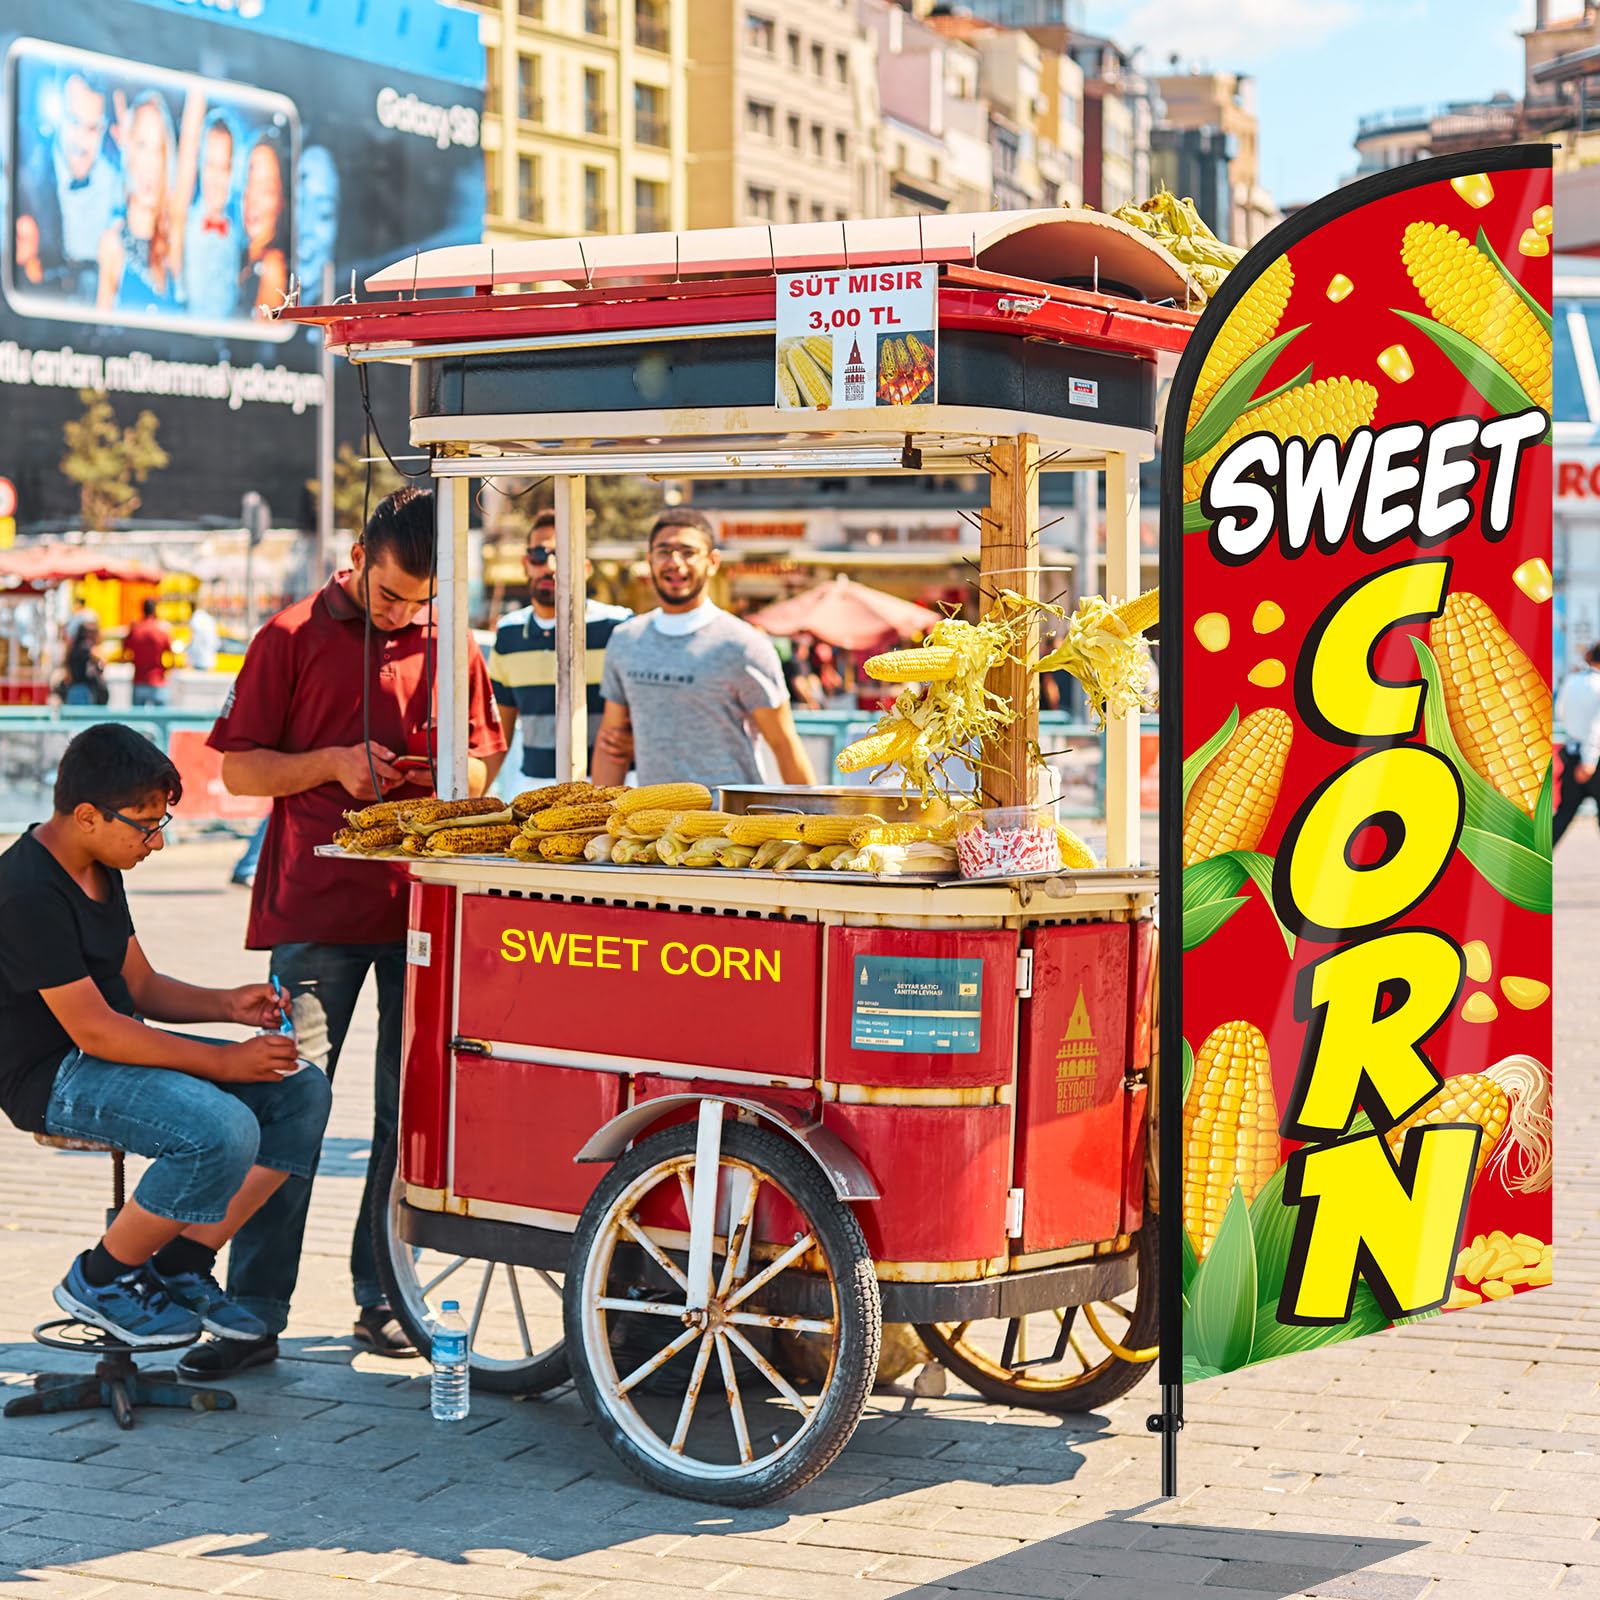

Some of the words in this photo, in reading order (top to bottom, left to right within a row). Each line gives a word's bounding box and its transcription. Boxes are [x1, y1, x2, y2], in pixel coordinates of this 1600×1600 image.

[377, 87, 450, 149] Galaxy
[789, 275, 840, 298] SÜT
[848, 271, 922, 294] MISIR
[809, 309, 861, 332] 3,00
[869, 306, 901, 325] TL
[1204, 408, 1549, 563] SWEET
[500, 928, 649, 972] SWEET
[660, 942, 781, 982] CORN
[1275, 557, 1482, 1325] CORN
[893, 988, 918, 996] TANITIM
